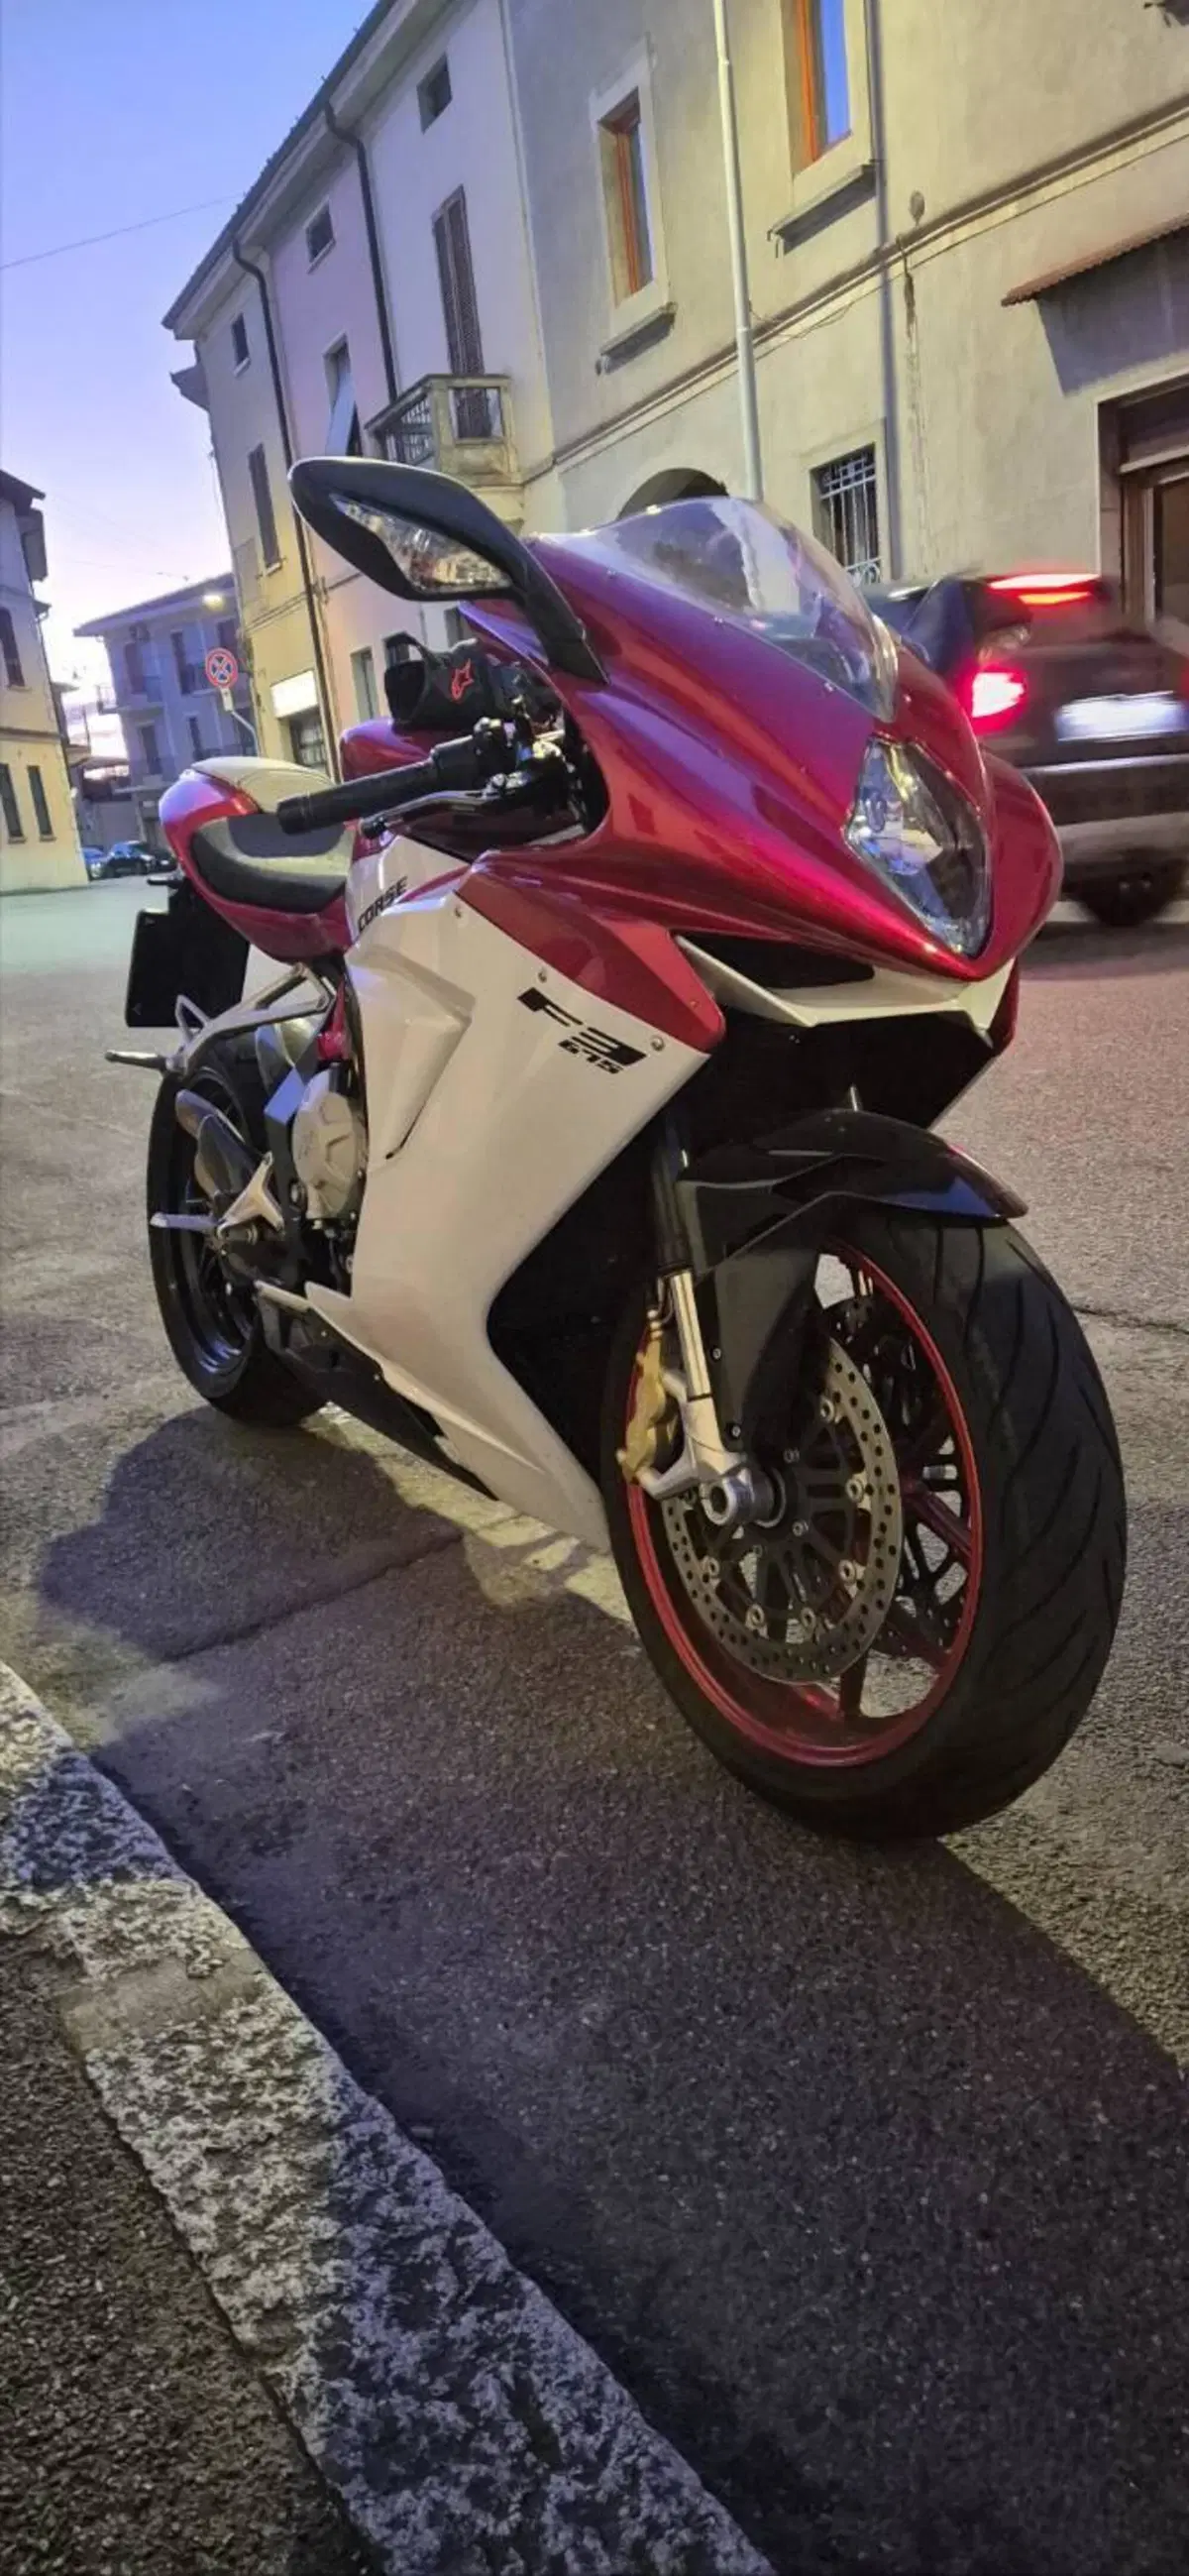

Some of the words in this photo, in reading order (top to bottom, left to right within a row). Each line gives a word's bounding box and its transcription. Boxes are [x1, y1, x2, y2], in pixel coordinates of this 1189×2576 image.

[358, 876, 408, 932] CORSE
[517, 987, 647, 1066] F3
[558, 1040, 624, 1074] 675
